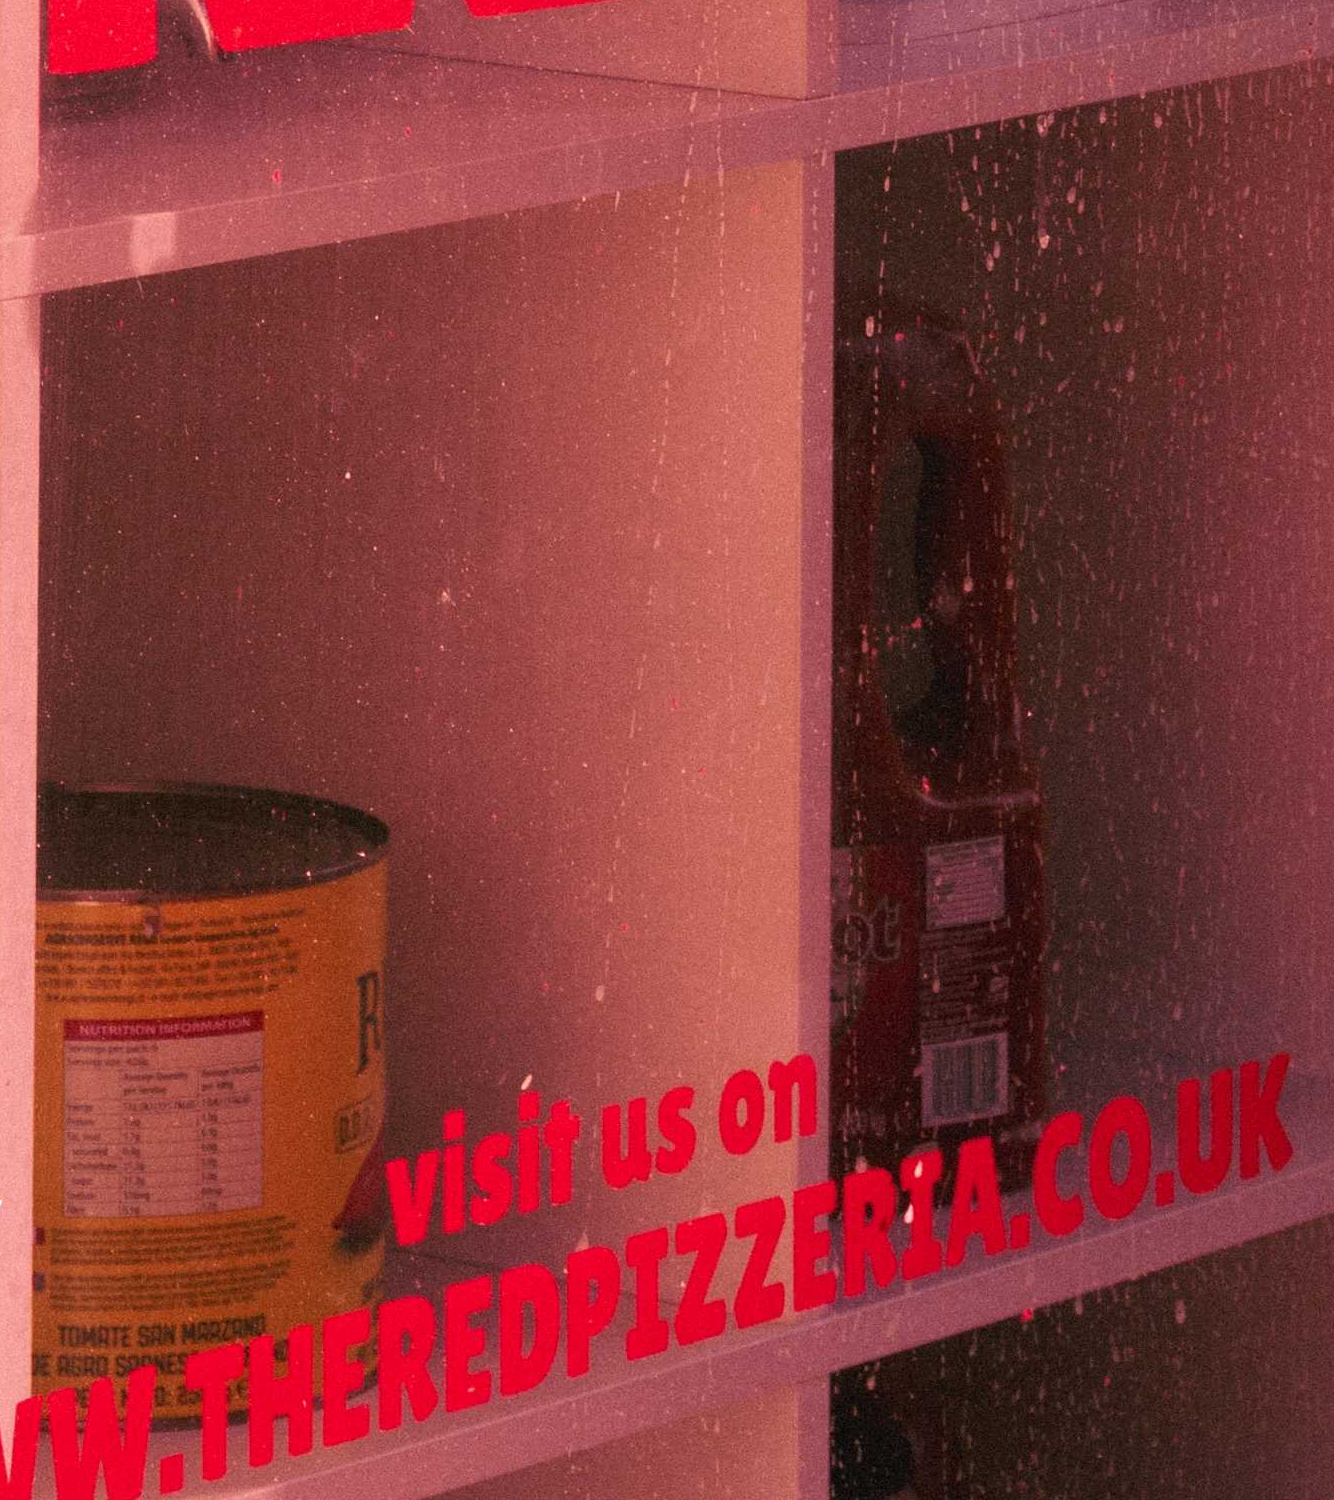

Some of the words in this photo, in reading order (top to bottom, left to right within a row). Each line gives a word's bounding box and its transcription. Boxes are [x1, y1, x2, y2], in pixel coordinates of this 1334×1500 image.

[79, 1024, 157, 1037] NUTRITION
[159, 1017, 252, 1035] INFORMATION
[385, 1090, 581, 1247] visit
[601, 1085, 697, 1190] us
[718, 1052, 818, 1156] on
[59, 1324, 130, 1347] TOMATE
[138, 1322, 175, 1346] SAN
[182, 1314, 266, 1343] MARZANO
